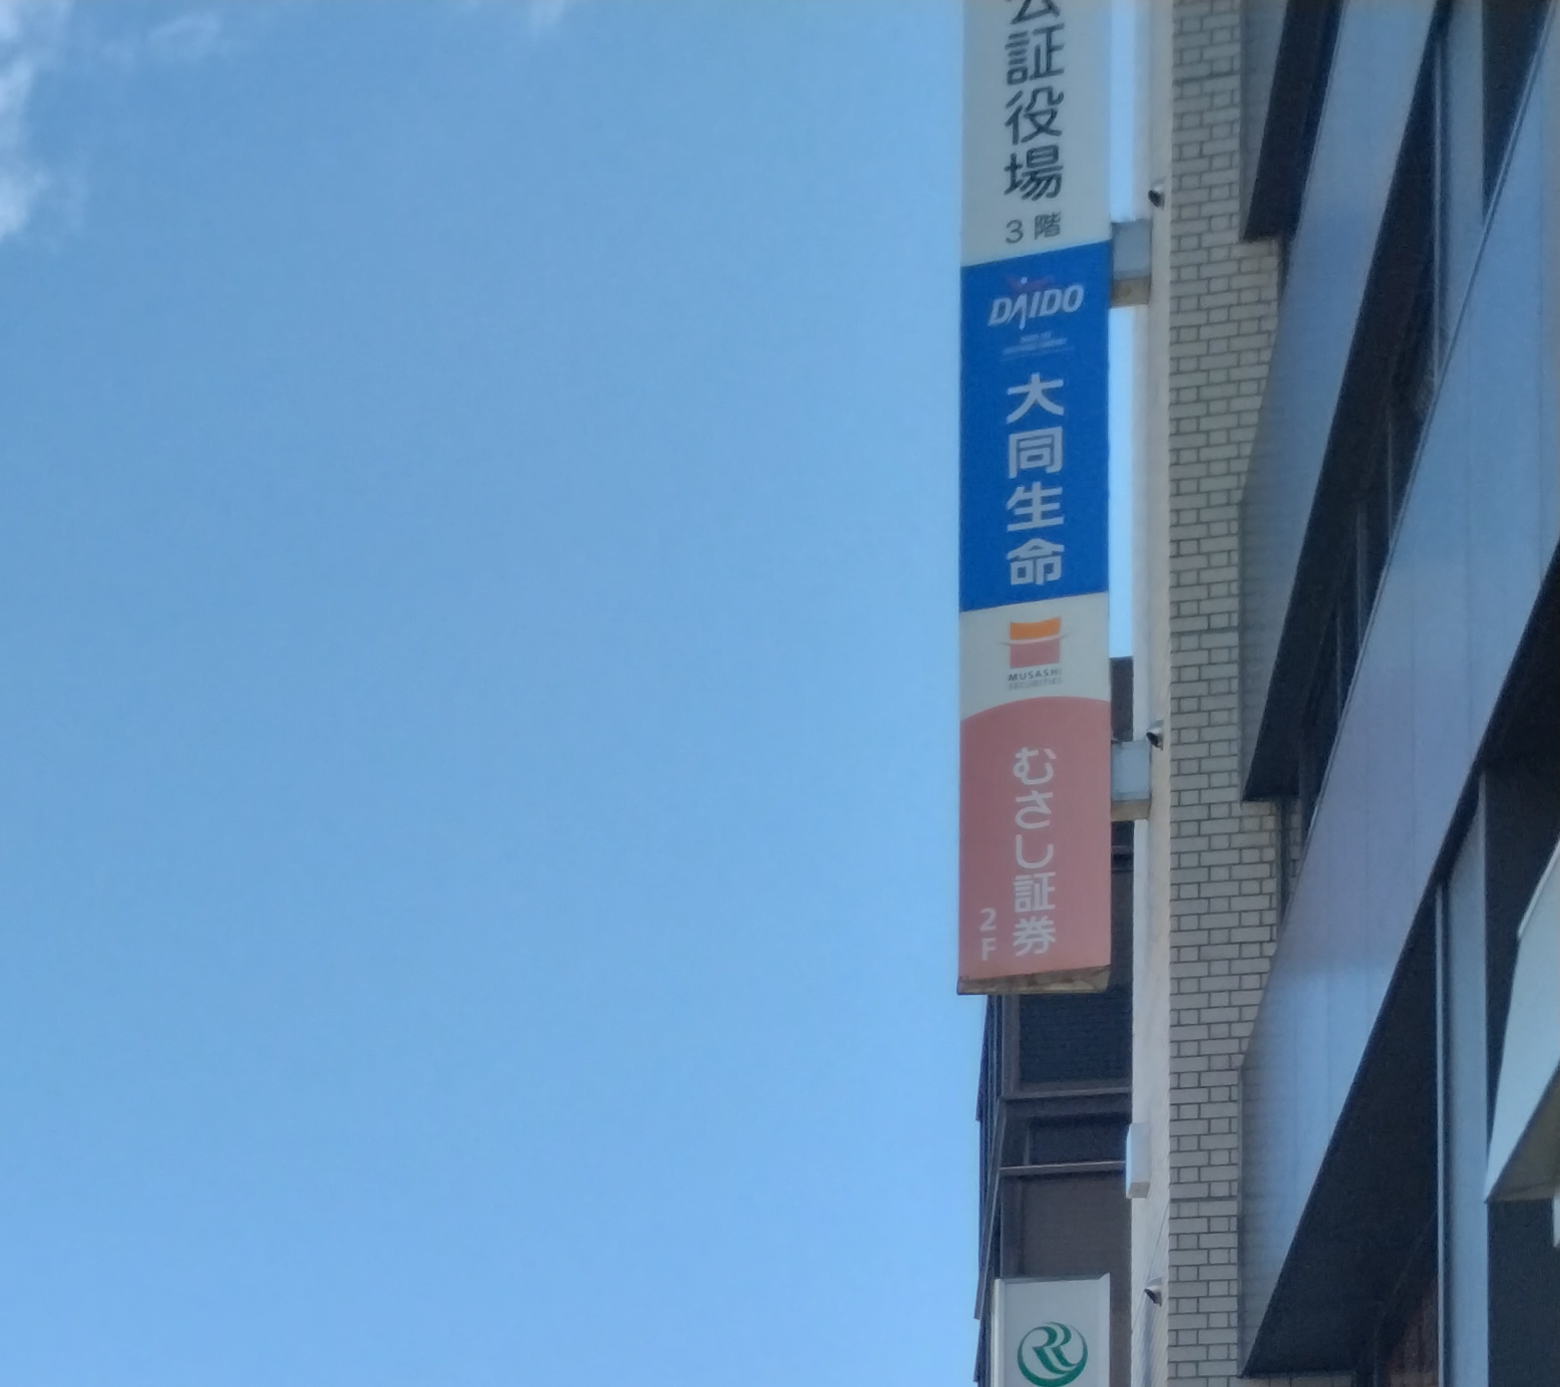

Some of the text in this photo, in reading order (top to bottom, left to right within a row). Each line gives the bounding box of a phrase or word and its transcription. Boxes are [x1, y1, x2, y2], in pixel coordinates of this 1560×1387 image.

[987, 283, 1085, 331] DAIDO
[1005, 373, 1065, 586] 大同生命
[1008, 667, 1063, 683] MUSASHI
[1011, 744, 1057, 959] むさし証券
